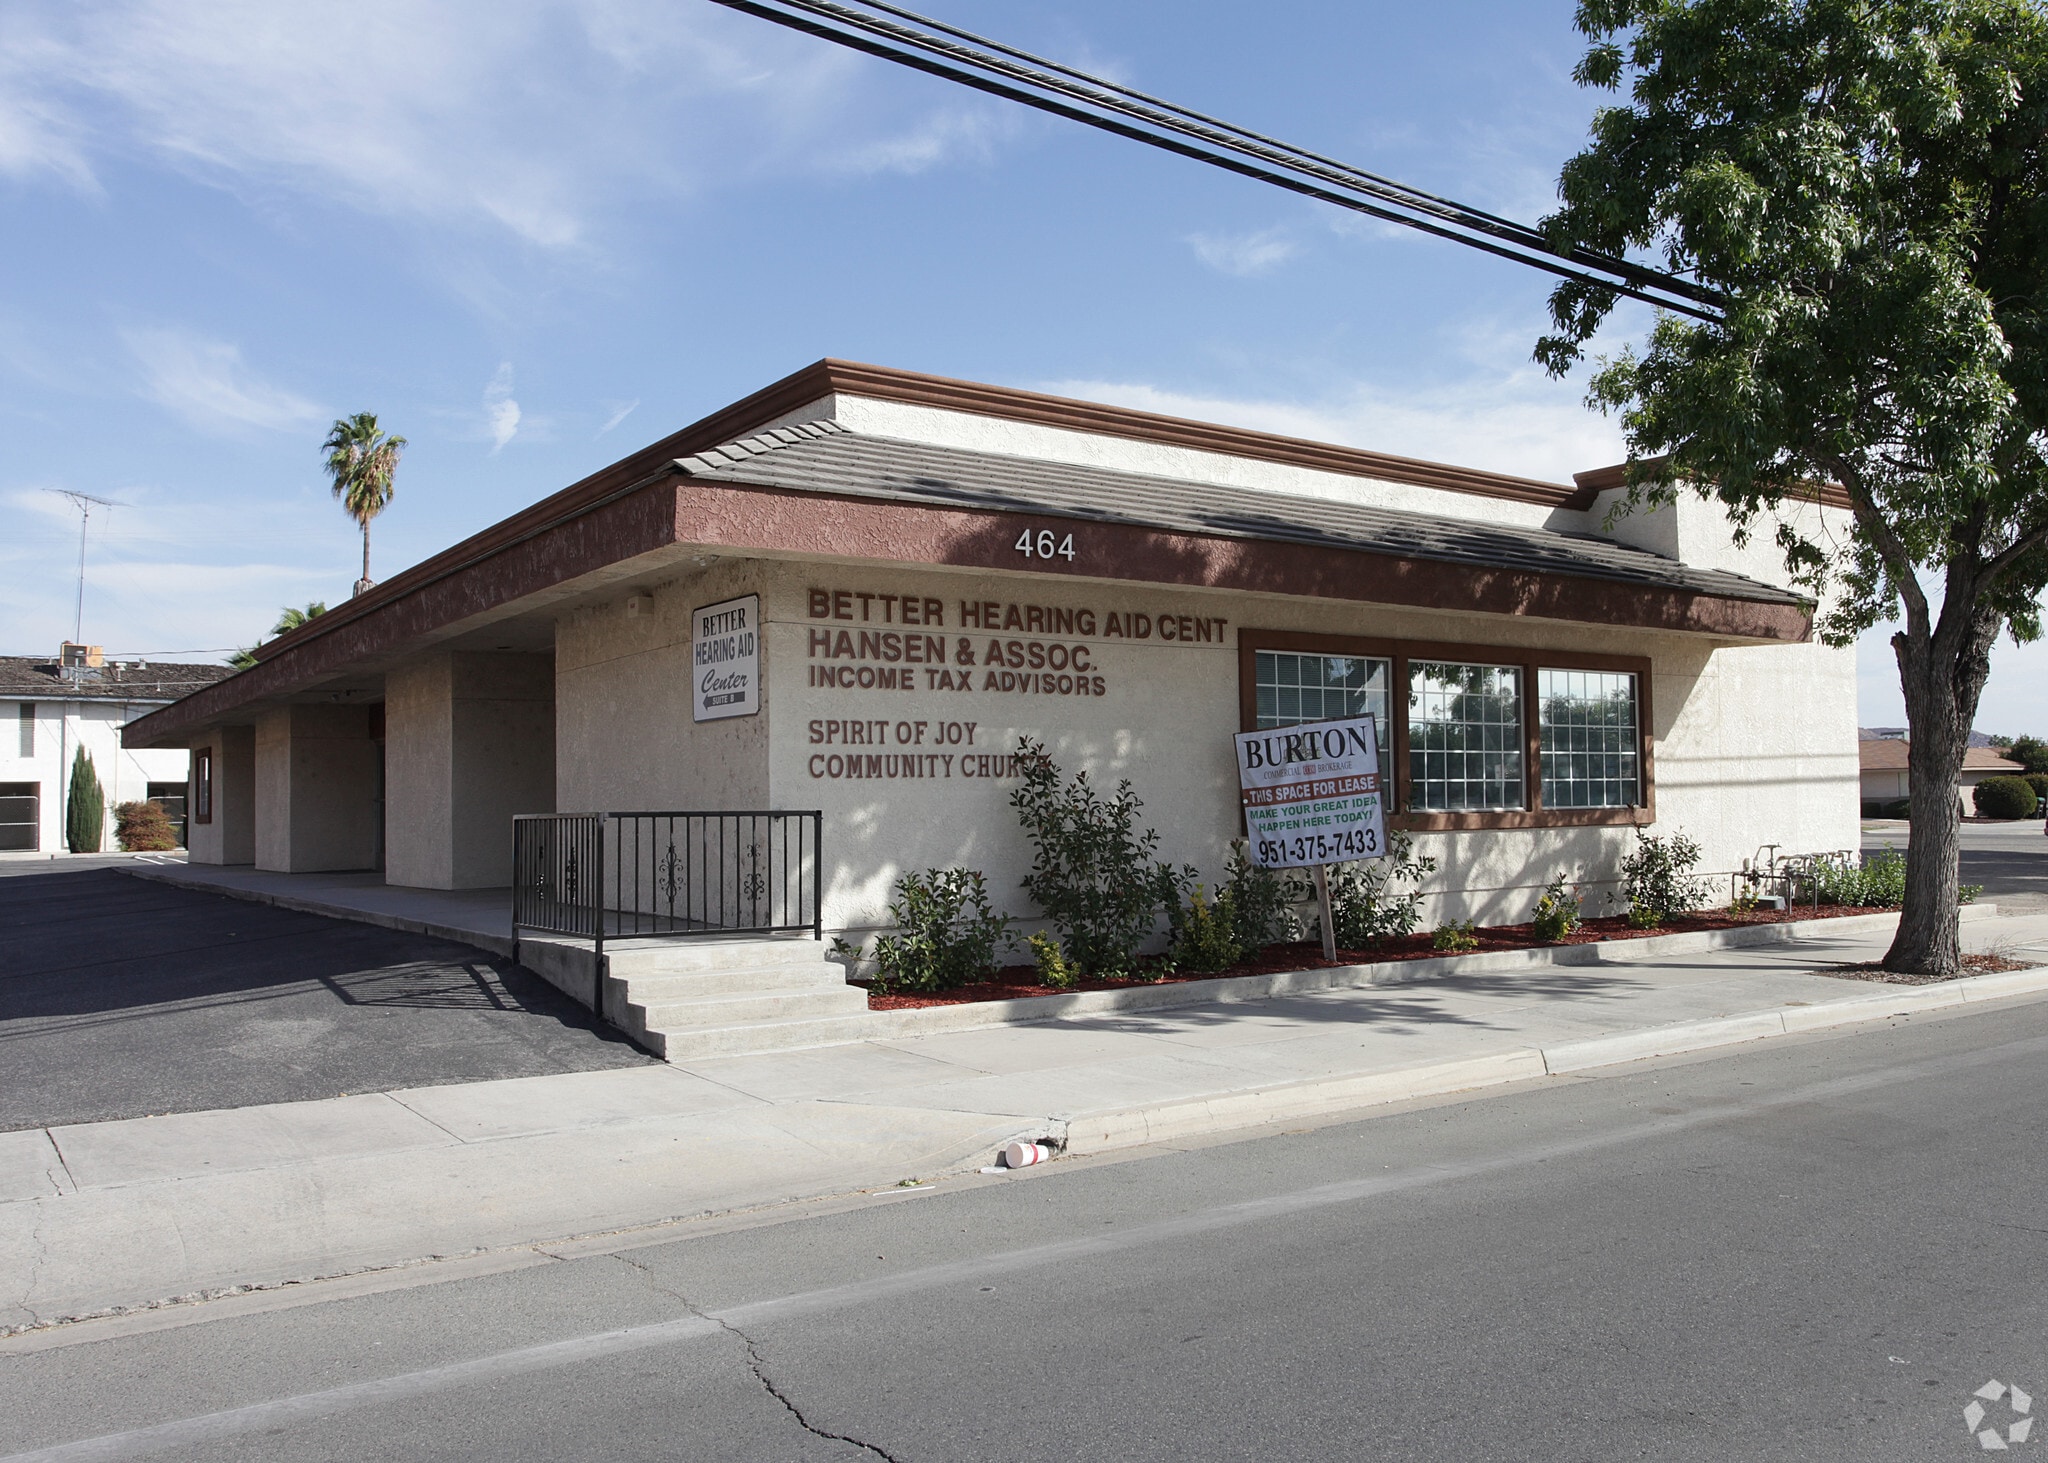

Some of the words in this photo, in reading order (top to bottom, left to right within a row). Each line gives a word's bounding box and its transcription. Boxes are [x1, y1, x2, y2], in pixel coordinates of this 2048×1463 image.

[1015, 529, 1075, 561] 464
[702, 608, 746, 638] BETTER
[808, 590, 943, 626] BETTER
[960, 601, 1096, 636] HEARING
[1103, 611, 1152, 640] AID
[1158, 614, 1228, 643] CENT
[695, 636, 735, 666] HEARING
[738, 632, 754, 658] AID
[808, 629, 945, 664] HANSEN
[956, 638, 977, 666] &
[983, 639, 1099, 673] ASSOC.
[701, 668, 749, 694] Center
[809, 665, 914, 691] INCOME
[925, 668, 973, 692] TAX
[983, 672, 1106, 697] ADVISORS
[712, 694, 728, 705] SUITE
[808, 719, 889, 745] SPIRIT
[895, 721, 928, 745] OF
[935, 721, 977, 745] JOY
[1244, 726, 1368, 769] BURTON
[808, 754, 955, 779] COMMUNITY
[1263, 766, 1301, 780] COMMERCIAL
[1317, 761, 1352, 773] BROKERAGE
[1249, 790, 1273, 803] THIS
[1275, 784, 1311, 801] SPACE
[1313, 781, 1336, 796] FOR
[1338, 776, 1375, 793] LEASE
[1250, 808, 1278, 820] MAKE
[1281, 804, 1311, 817] YOUR
[1313, 799, 1348, 813] GREAT
[1352, 796, 1377, 808] IDEA
[1258, 819, 1300, 832] HAPPEN
[1303, 815, 1331, 827] HERE
[1334, 810, 1373, 823] TODAY!
[1258, 828, 1377, 863] 951-375-7433
